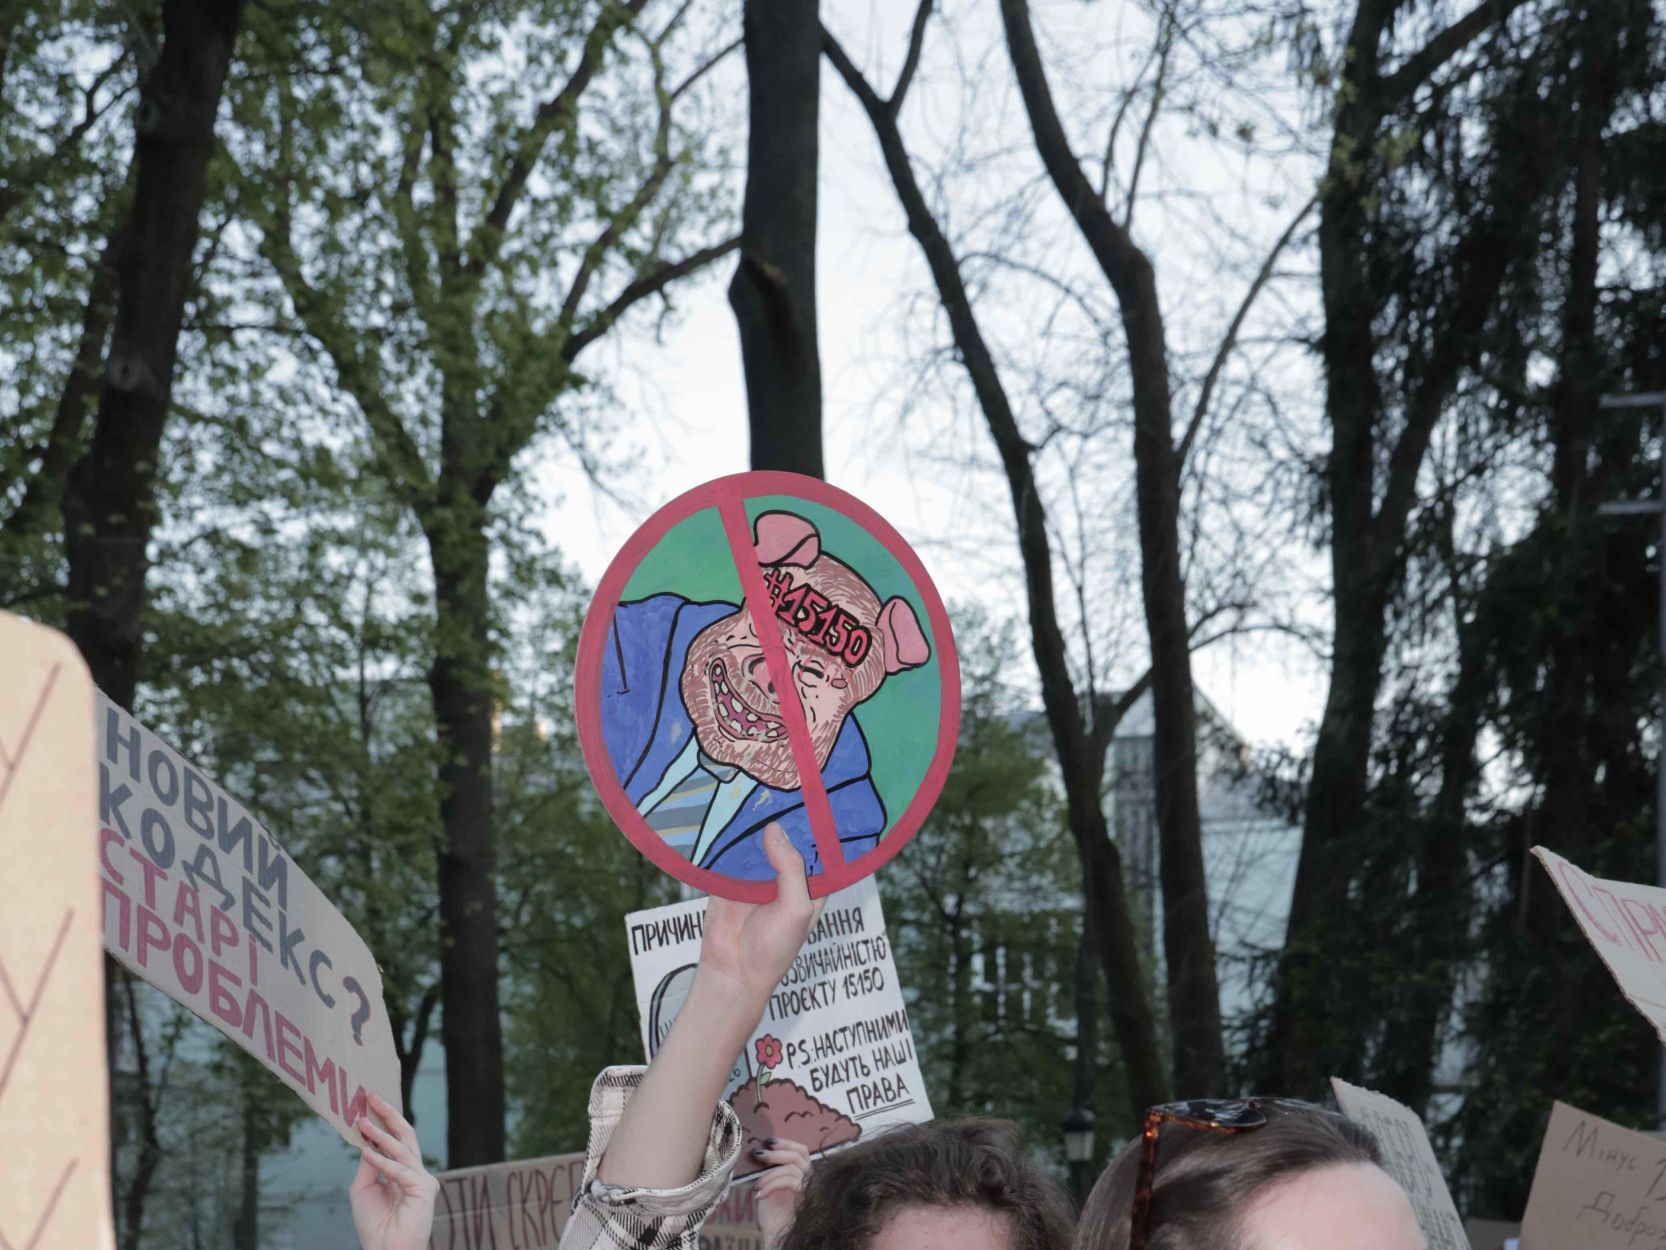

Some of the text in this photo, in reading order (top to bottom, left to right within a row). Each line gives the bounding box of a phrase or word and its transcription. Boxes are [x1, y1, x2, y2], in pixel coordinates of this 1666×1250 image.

[105, 706, 288, 913] НОВИЙ
[97, 827, 259, 986] СТАРІ
[98, 761, 372, 1047] КОДЕКС?
[631, 909, 706, 956] ПРИЧИН
[101, 878, 368, 1129] ПРОБЛЕМИ
[768, 966, 885, 1021] ПРОЄКТУ 15150
[812, 1009, 909, 1061] НАСТУПНИМИ
[809, 1038, 913, 1093] БУДУТЬ НАШІ
[845, 1072, 911, 1115] ПРАВА
[1561, 1119, 1641, 1172] Мінус
